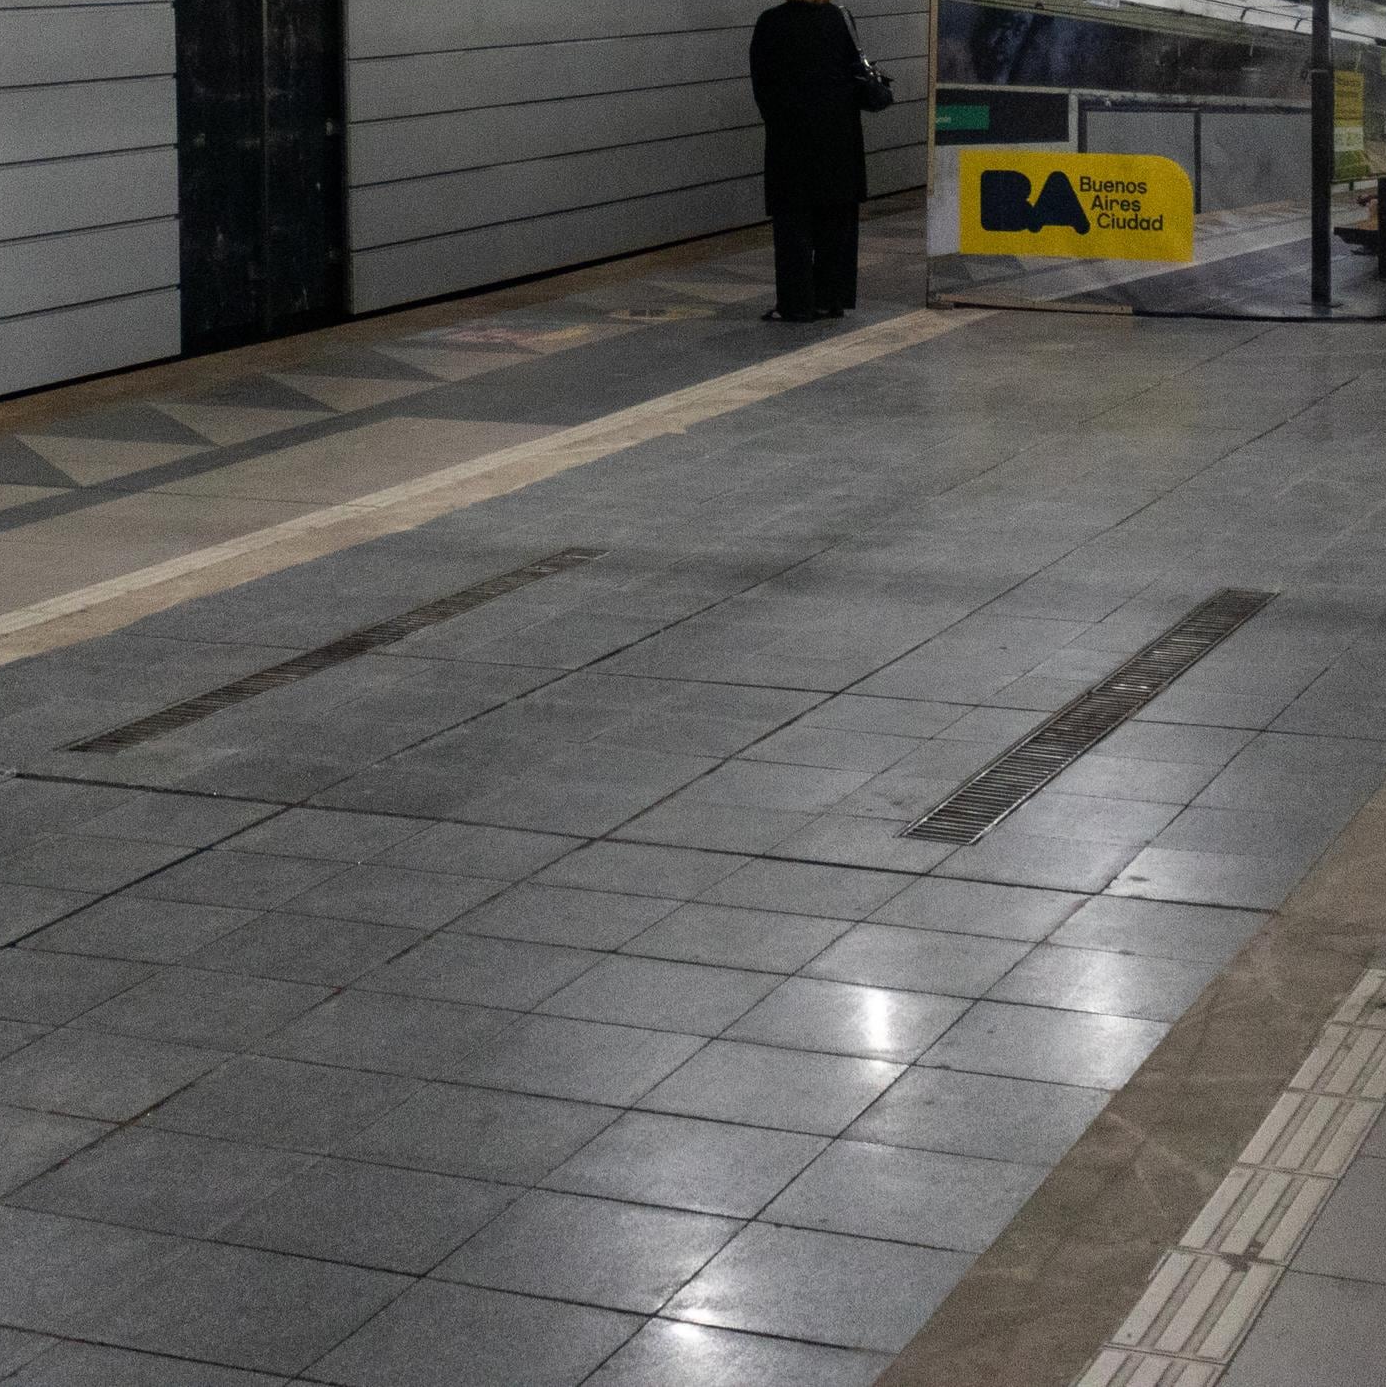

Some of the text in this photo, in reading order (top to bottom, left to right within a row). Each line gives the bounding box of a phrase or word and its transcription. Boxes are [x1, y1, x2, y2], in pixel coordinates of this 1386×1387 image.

[1079, 176, 1148, 194] Buenos
[980, 169, 1091, 235] BA
[1090, 194, 1141, 213] Aires
[1097, 213, 1164, 231] Ciudad
